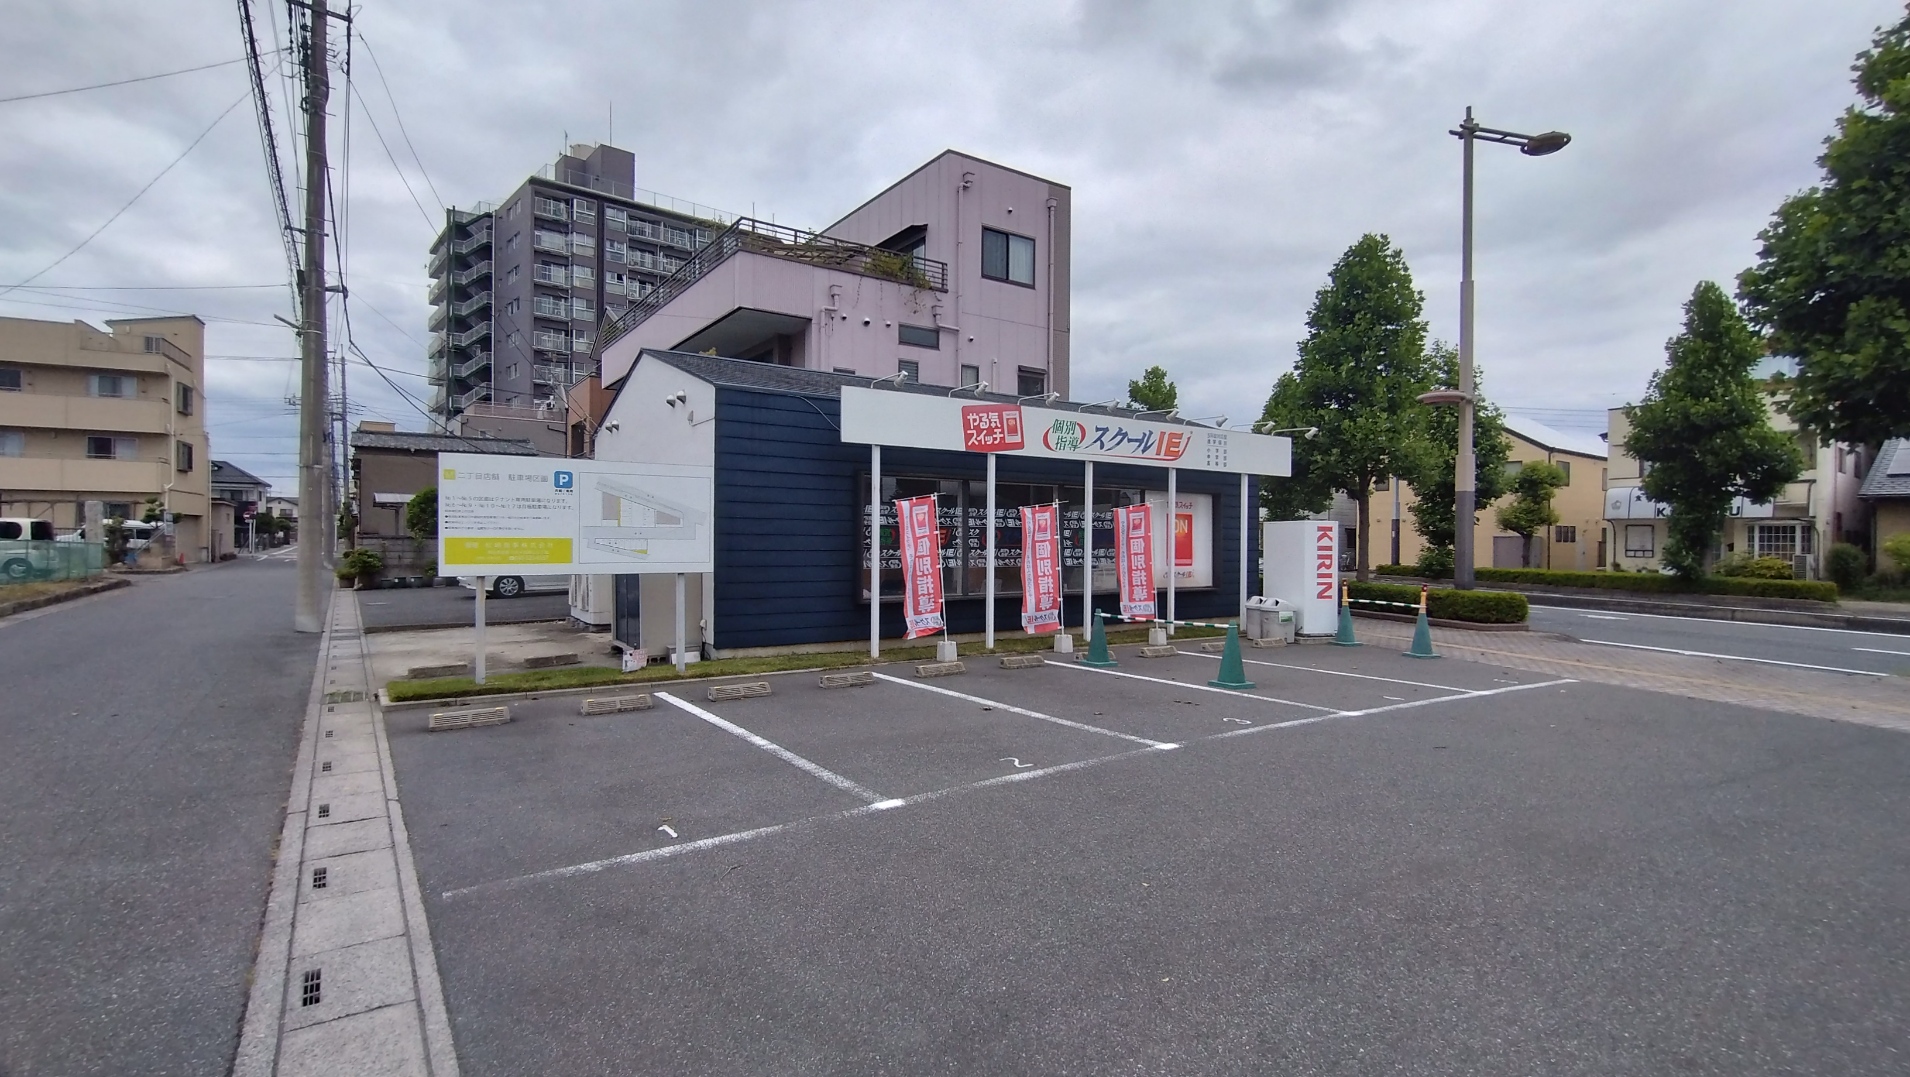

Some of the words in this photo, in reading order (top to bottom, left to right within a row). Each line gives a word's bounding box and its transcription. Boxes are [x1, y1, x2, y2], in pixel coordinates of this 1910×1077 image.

[967, 412, 1001, 429] やる気
[1052, 418, 1077, 435] 個別
[967, 429, 1004, 446] スイッチ
[1055, 435, 1080, 452] 指導
[1083, 425, 1184, 457] スクールIE
[1317, 525, 1334, 600] KIRIN
[1222, 717, 1252, 725] 3
[998, 757, 1034, 768] 2
[657, 824, 678, 838] 1
